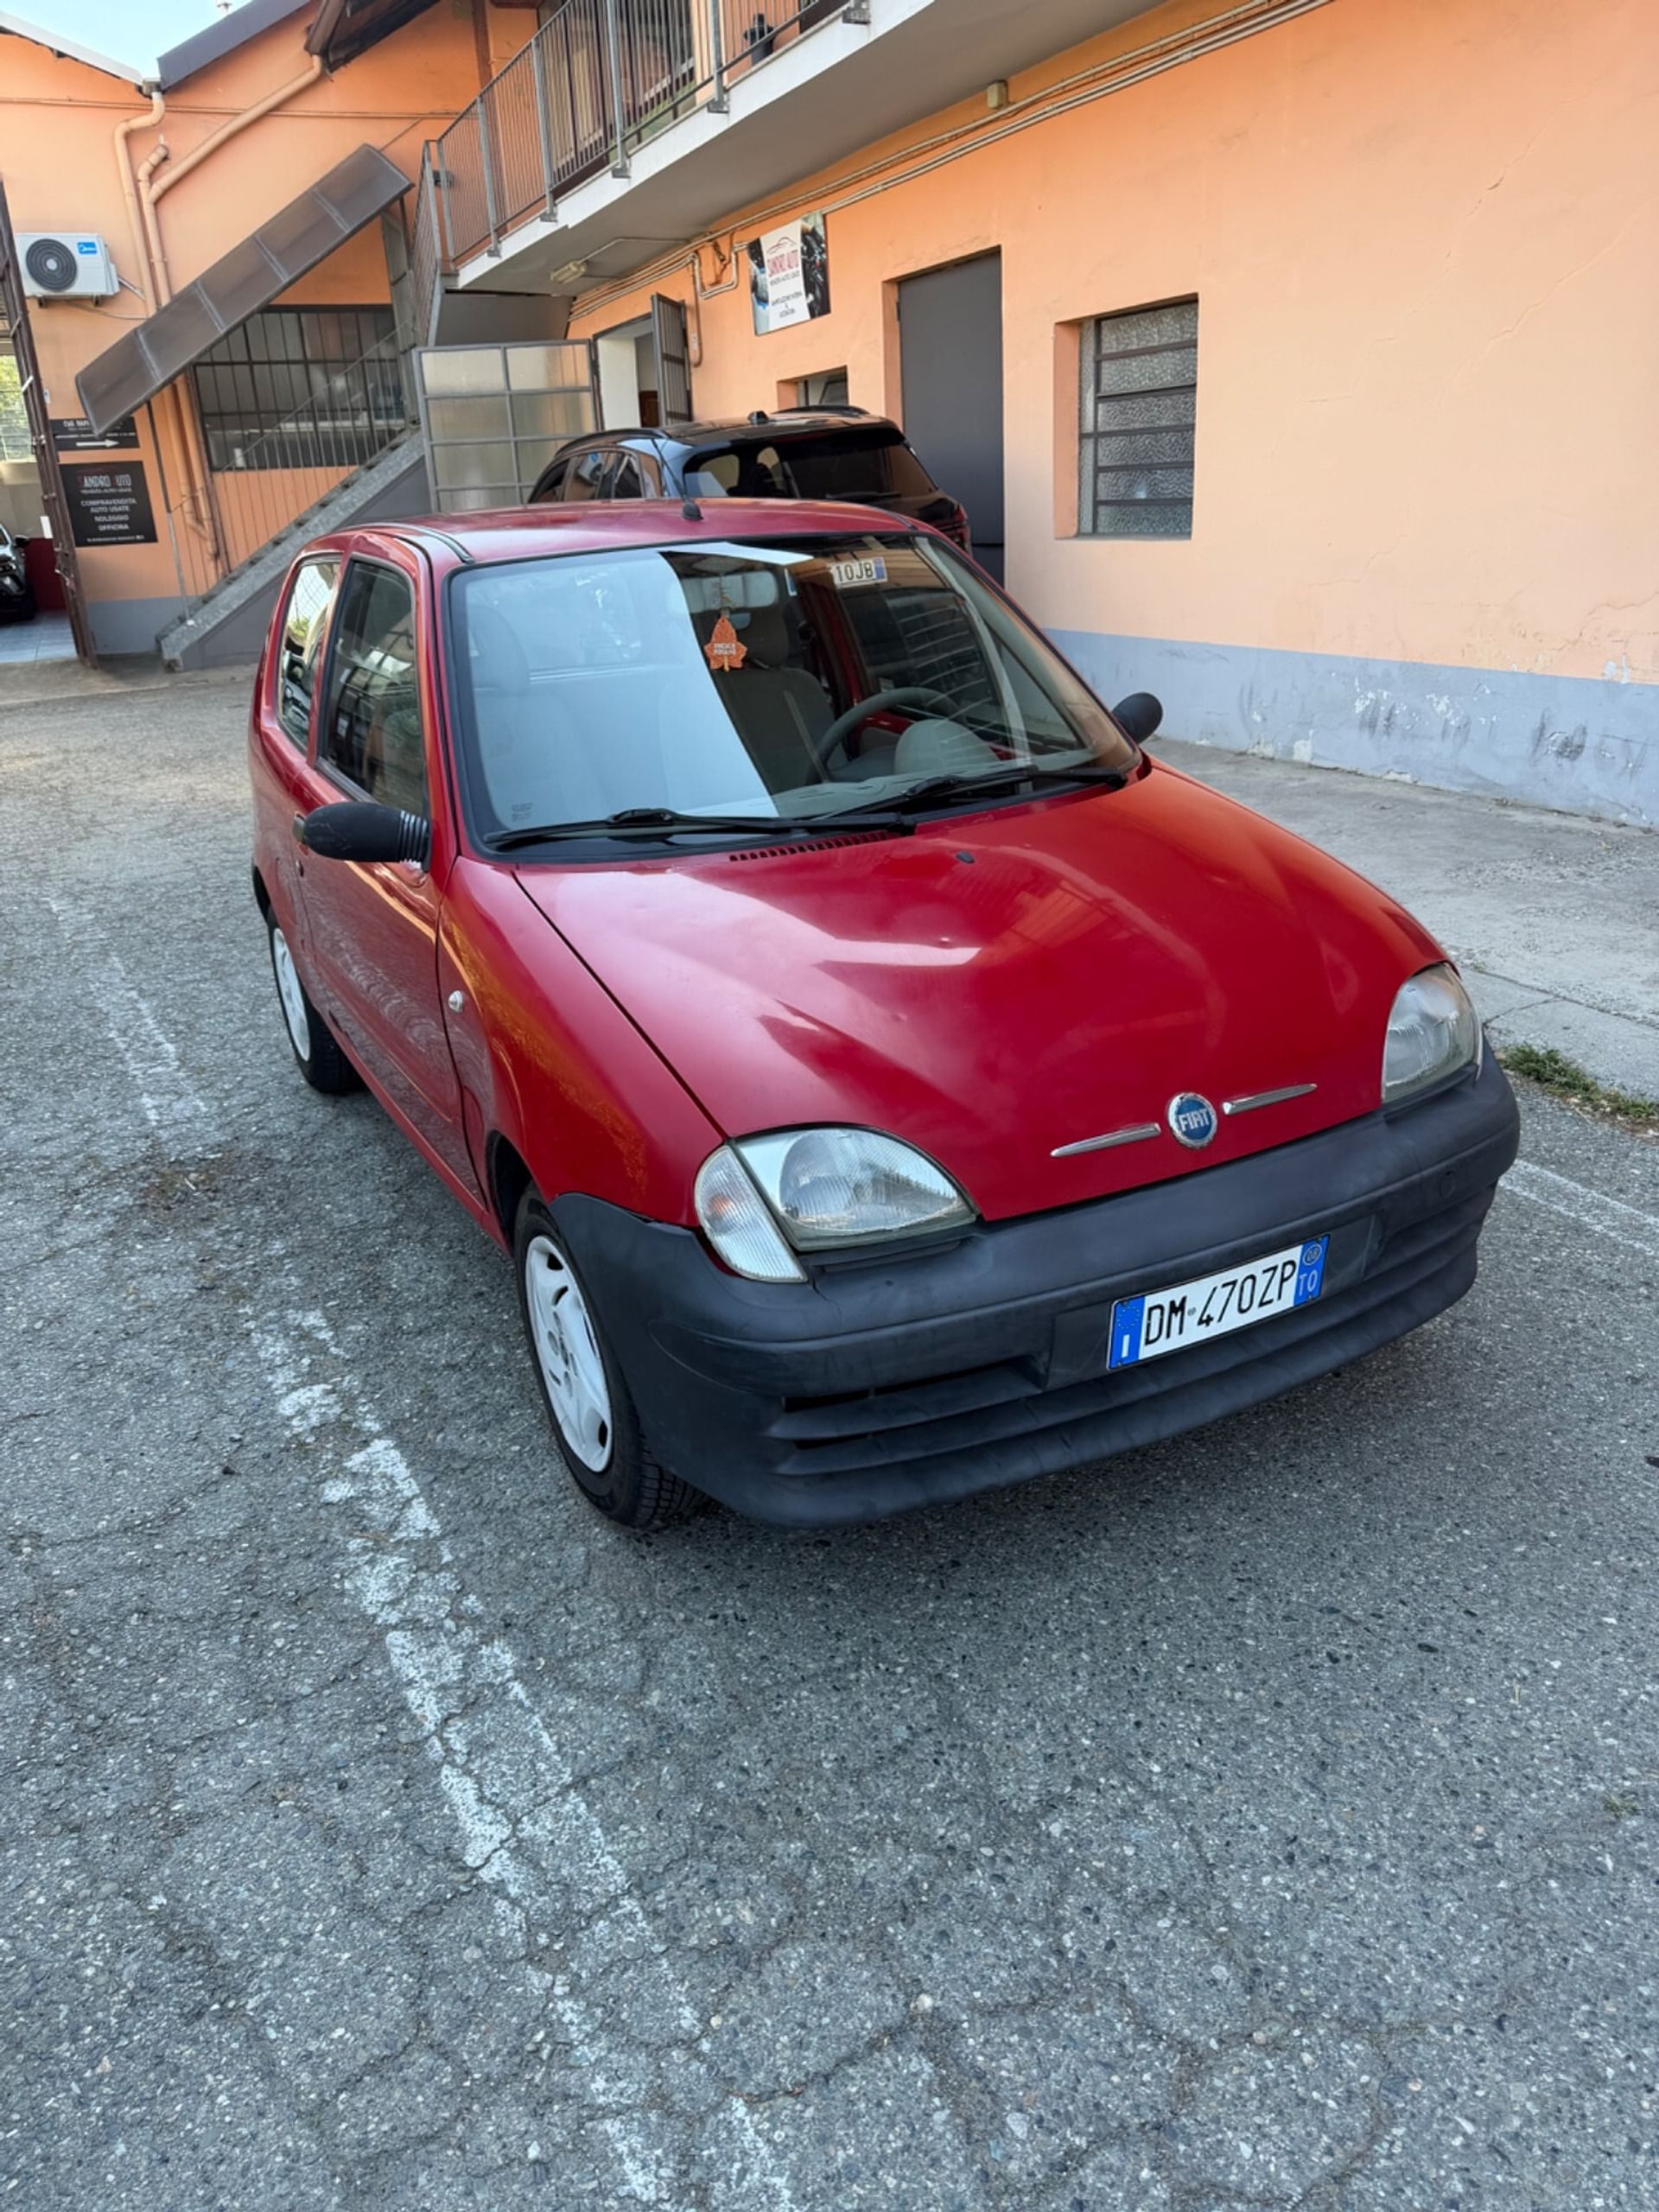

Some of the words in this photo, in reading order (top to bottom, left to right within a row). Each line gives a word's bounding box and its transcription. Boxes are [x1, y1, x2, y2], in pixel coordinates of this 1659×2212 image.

[1178, 1108, 1210, 1132] FIAT
[1144, 1295, 1187, 1346] DM
[1197, 1260, 1296, 1328] 470ZP
[1299, 1270, 1318, 1296] TO
